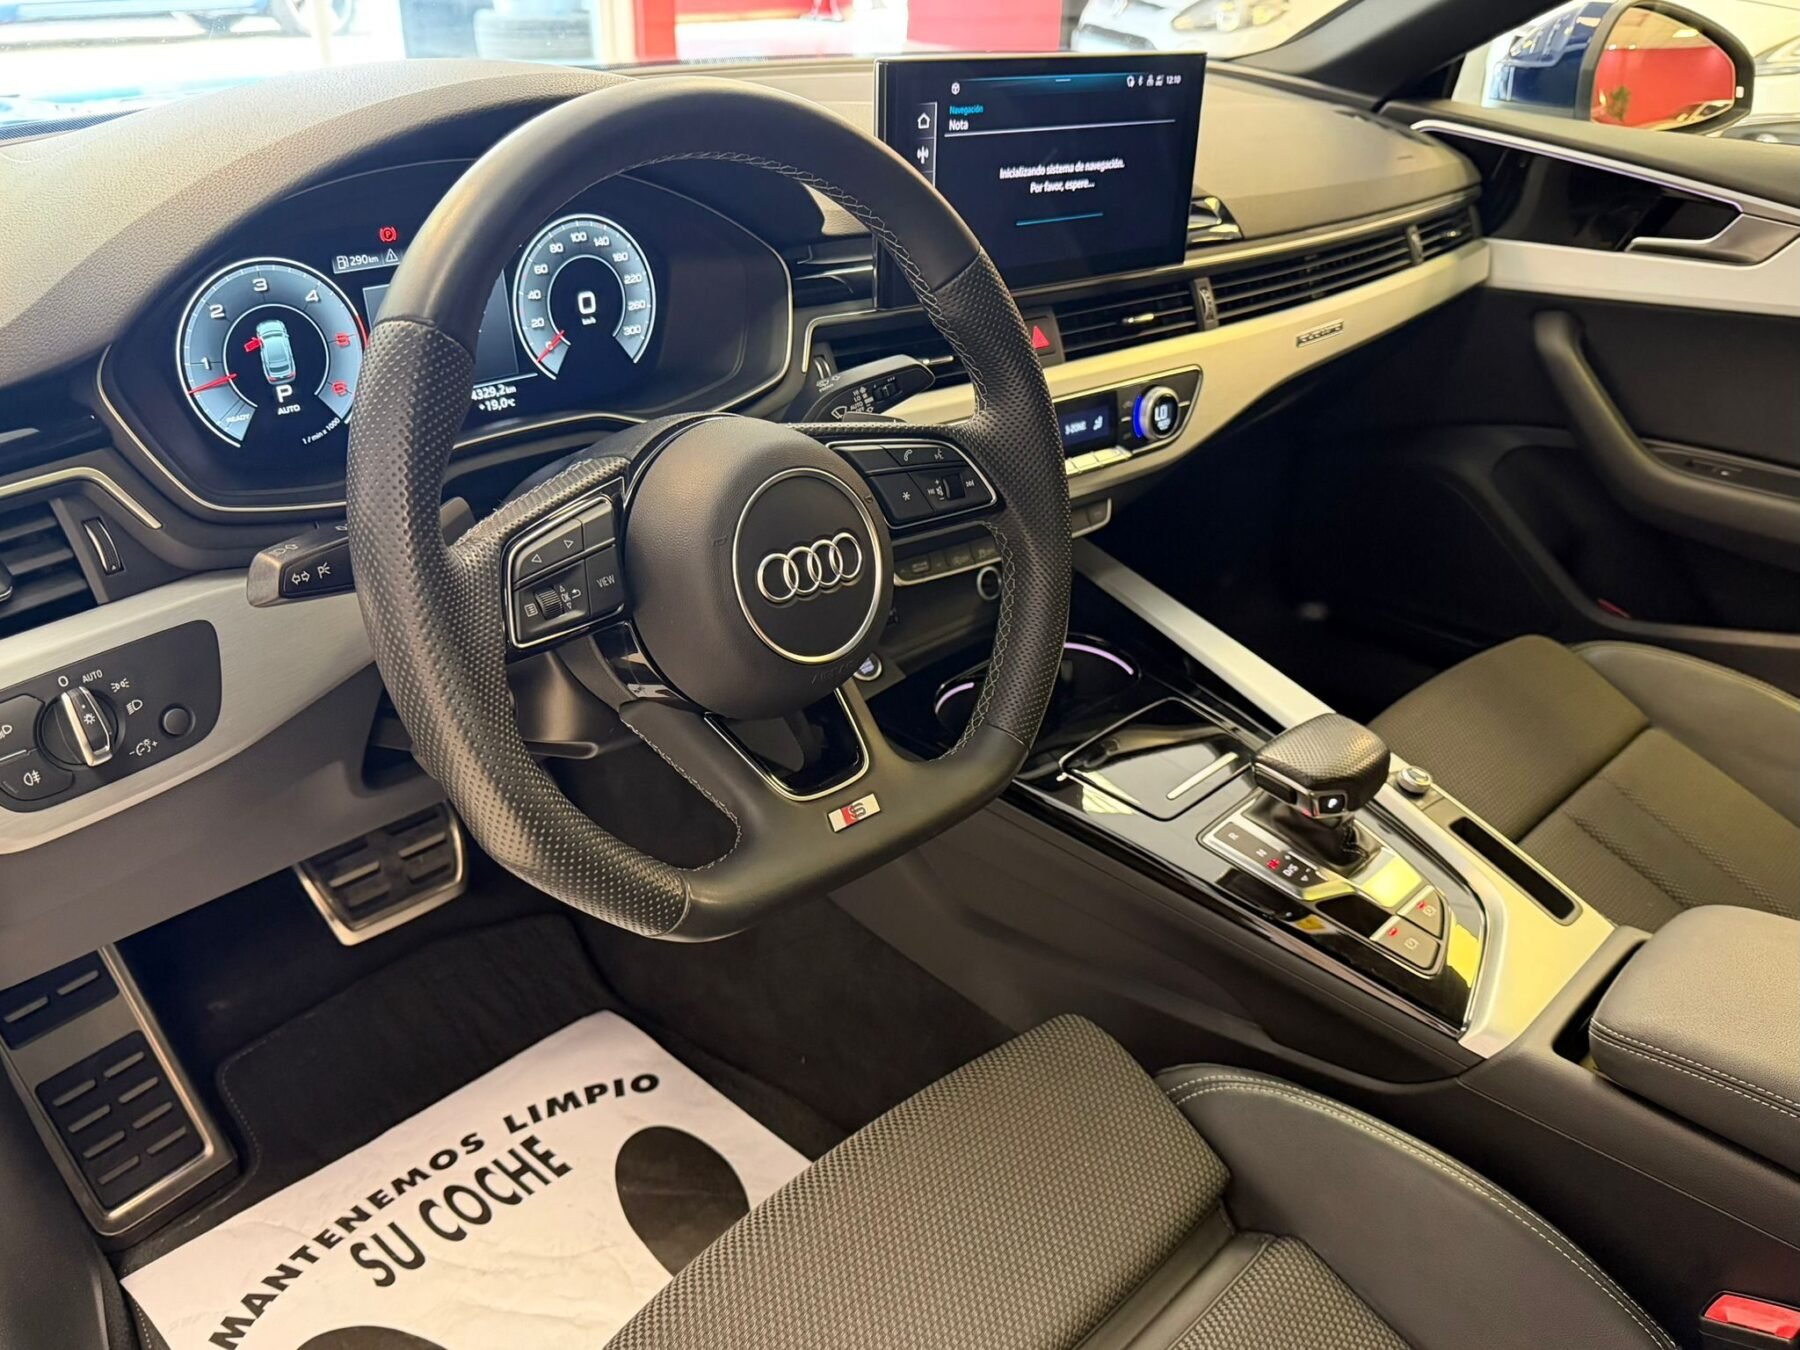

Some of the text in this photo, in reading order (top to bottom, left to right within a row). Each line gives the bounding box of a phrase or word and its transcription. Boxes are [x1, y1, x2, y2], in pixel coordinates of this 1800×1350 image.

[949, 104, 984, 116] Navegación
[949, 119, 969, 131] Nota
[1000, 164, 1046, 179] Inicializando
[1047, 162, 1074, 176] sistema
[1075, 160, 1084, 172] de
[1030, 182, 1044, 193] Por
[1044, 180, 1064, 192] favor,
[570, 231, 588, 244] 100
[593, 235, 611, 248] 140
[549, 243, 565, 254] 80
[612, 252, 630, 263] 180
[534, 264, 549, 275] 60
[252, 277, 269, 293] 3
[624, 274, 643, 285] 220
[305, 289, 320, 304] 4
[527, 290, 542, 301] 40
[577, 291, 597, 315] 0
[628, 300, 647, 311] 260
[210, 303, 226, 320] 2
[531, 317, 546, 329] 20
[623, 325, 643, 337] 300
[201, 356, 211, 371] 1
[275, 384, 294, 403] P
[277, 404, 301, 415] AUTO
[596, 574, 616, 588] VIEW
[82, 669, 103, 684] AUTO
[208, 1074, 661, 1350] MANTENEMOS LIMPIO
[349, 1135, 574, 1288] SU COCHE
